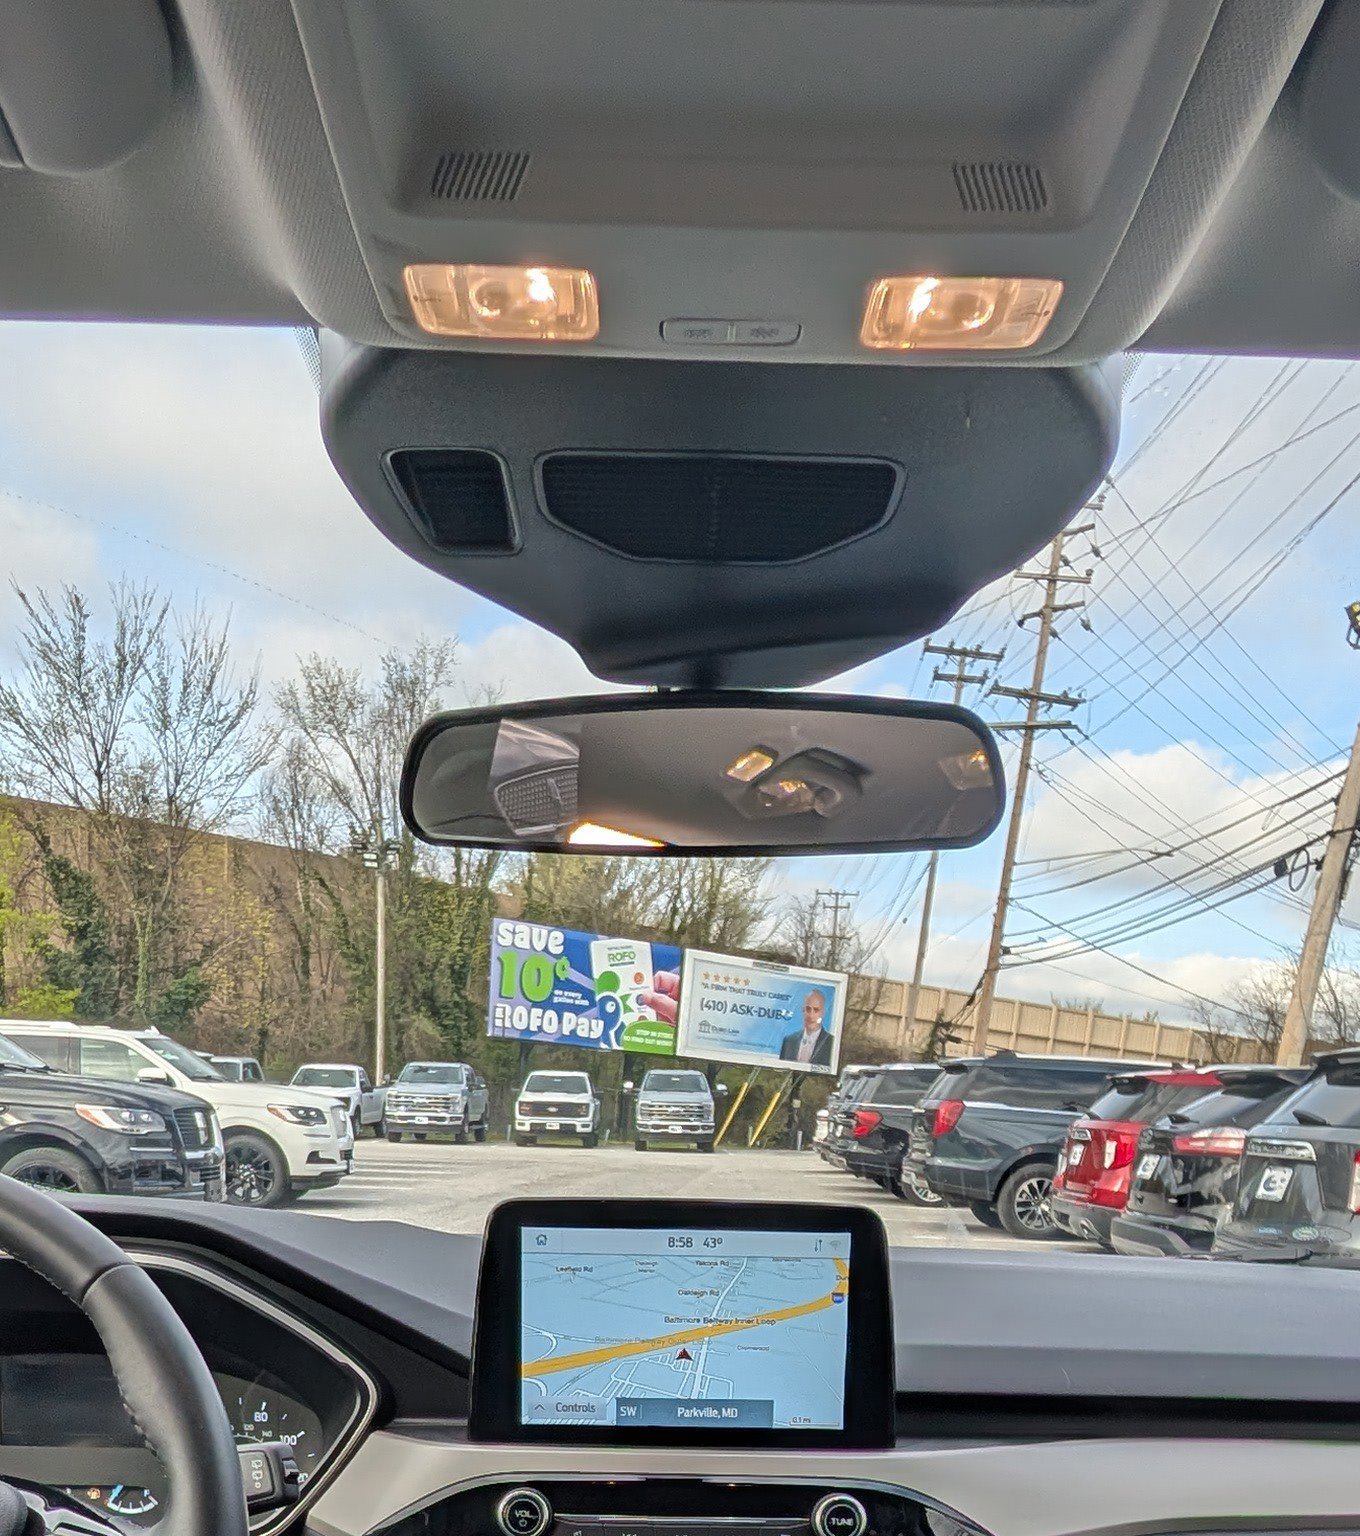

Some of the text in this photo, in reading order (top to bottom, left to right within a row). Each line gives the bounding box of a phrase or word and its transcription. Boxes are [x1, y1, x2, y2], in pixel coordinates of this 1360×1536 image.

[607, 951, 636, 963] ROFO
[746, 989, 767, 998] TRULY
[700, 998, 728, 1014] (410)
[495, 1003, 605, 1039] ROFO Pay
[668, 1236, 693, 1248] 8:58
[720, 1259, 730, 1267] Rd
[710, 1289, 720, 1297] Rd
[664, 1316, 701, 1324] Baltimore
[703, 1316, 733, 1326] Beltway
[555, 1402, 596, 1413] Controls
[620, 1406, 637, 1416] SW
[677, 1407, 738, 1418] Parkville, MD
[254, 1411, 268, 1422] 80
[279, 1435, 297, 1446] 100
[514, 1509, 532, 1518] VOL
[830, 1517, 854, 1527] TUNE
